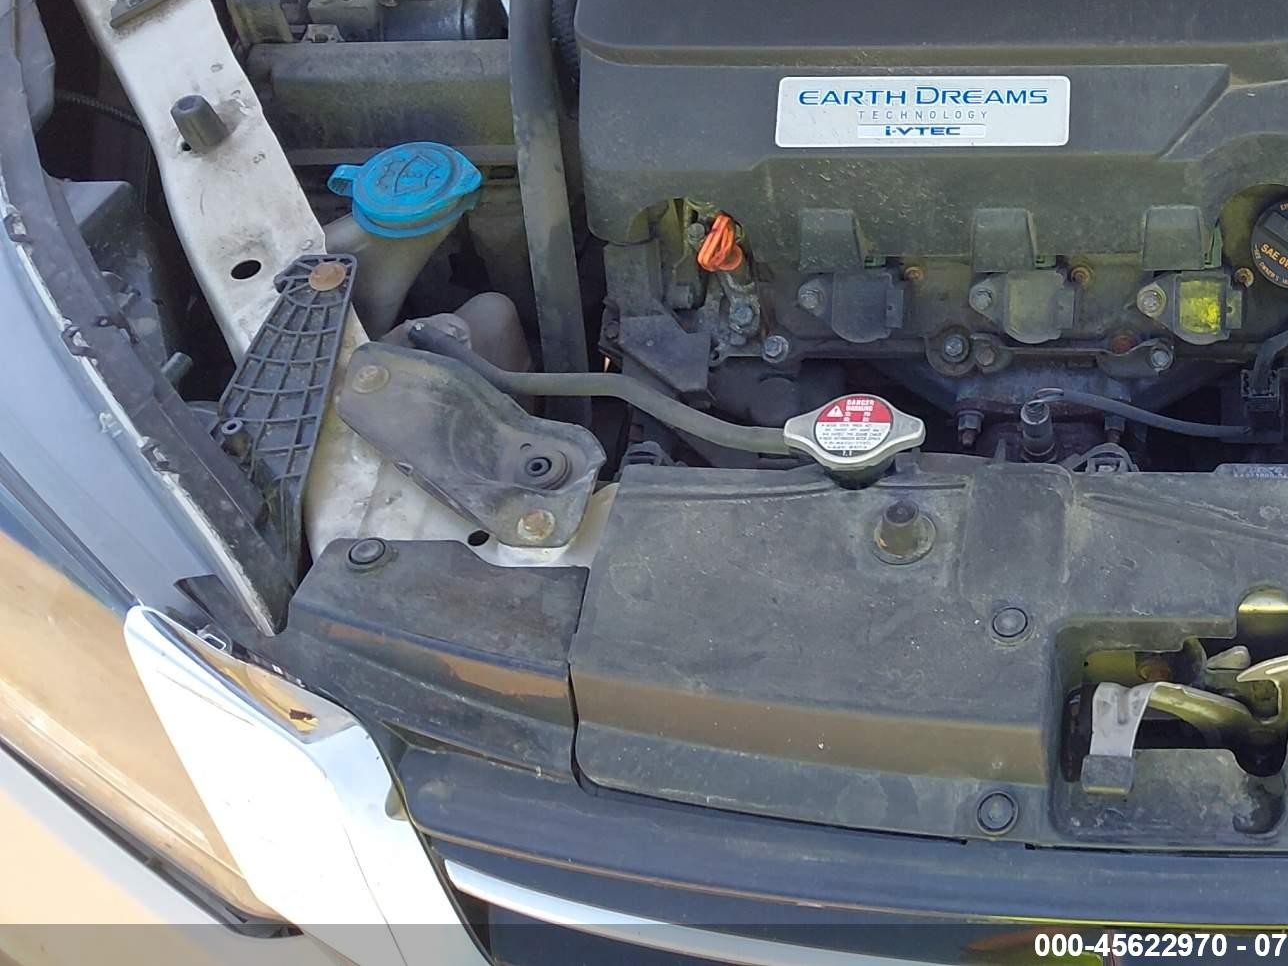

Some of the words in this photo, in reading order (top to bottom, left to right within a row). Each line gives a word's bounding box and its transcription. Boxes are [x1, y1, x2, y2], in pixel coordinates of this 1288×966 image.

[798, 89, 907, 106] EARTH
[915, 85, 1049, 105] DREAMS
[857, 109, 989, 120] TECHNOLOGY
[884, 125, 962, 137] i-VTEC
[1260, 243, 1280, 261] SAE
